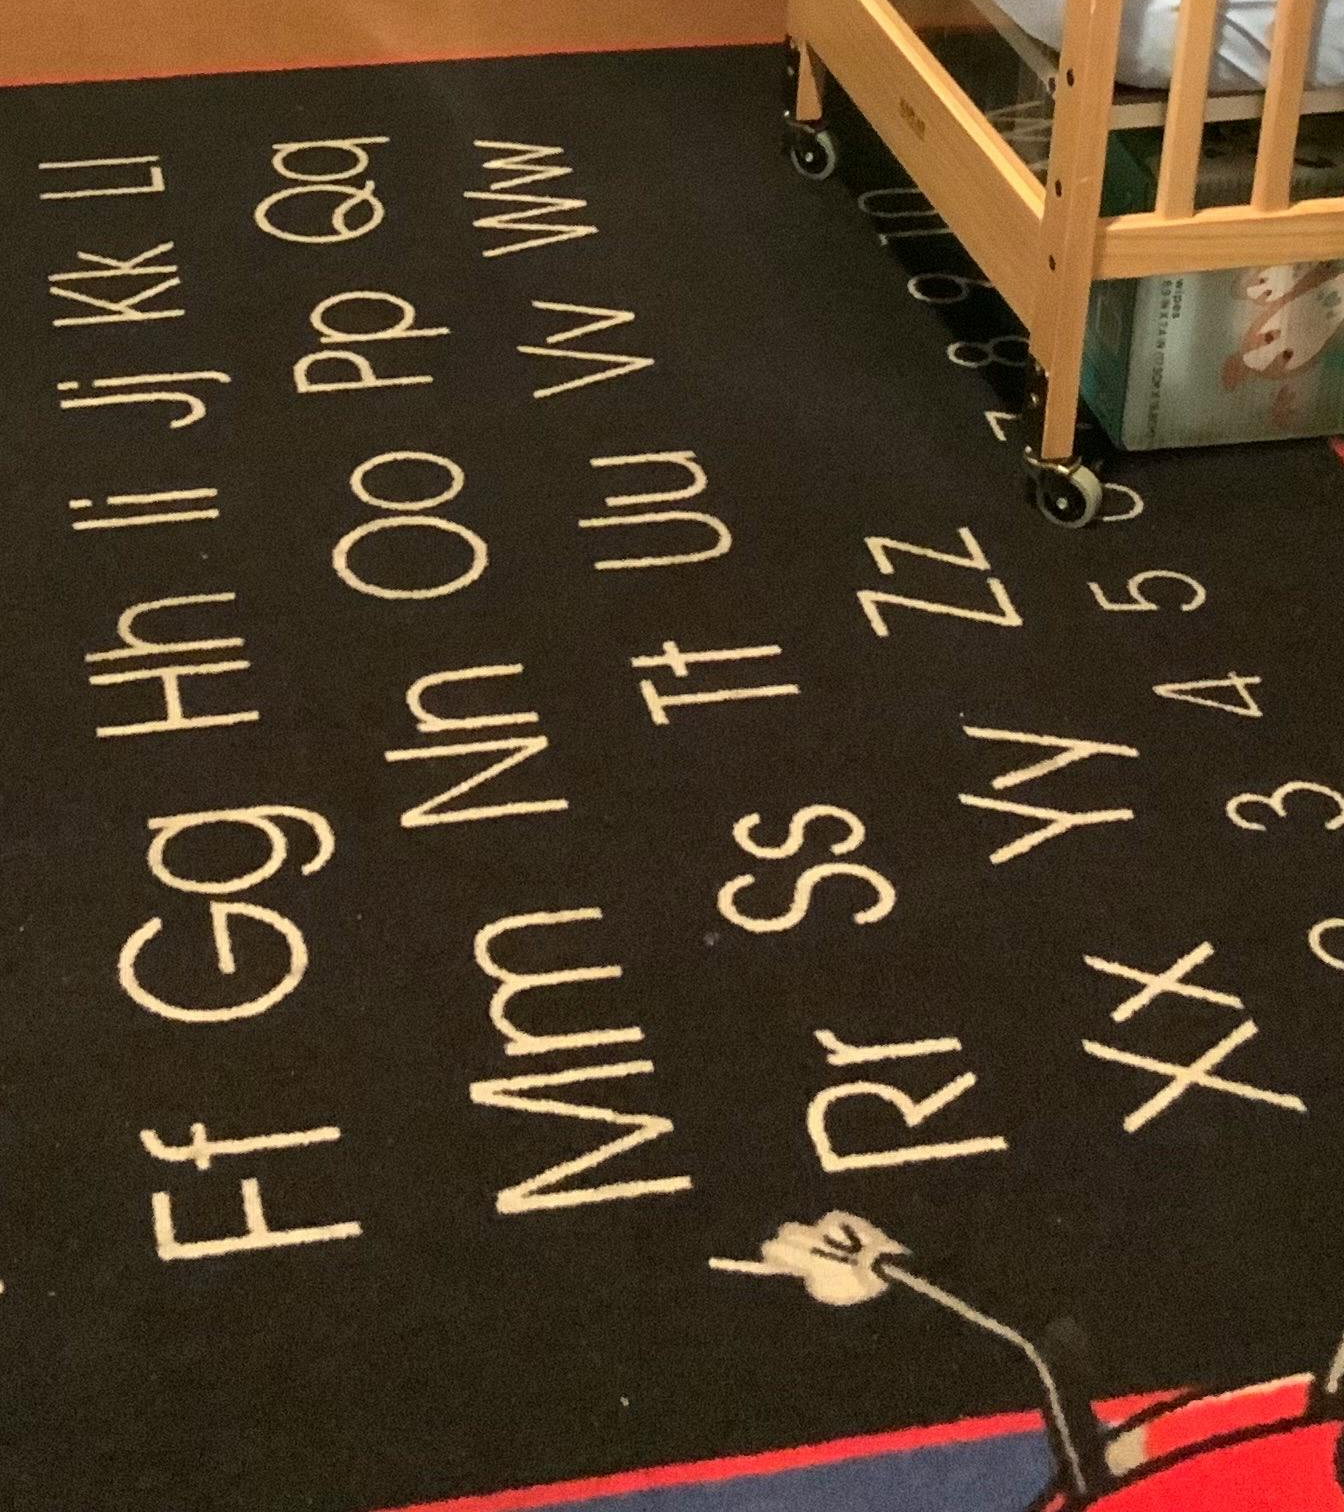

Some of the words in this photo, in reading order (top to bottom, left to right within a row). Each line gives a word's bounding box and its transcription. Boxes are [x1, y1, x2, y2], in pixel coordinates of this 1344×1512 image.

[254, 136, 388, 243] Qq
[464, 140, 597, 257] Ww
[49, 242, 184, 326] Kk
[294, 291, 449, 393] Pp
[1171, 278, 1184, 319] wipes
[57, 371, 230, 428] Jj
[518, 301, 654, 398] Vv
[947, 336, 1031, 368] 8
[332, 451, 488, 599] Oo
[579, 451, 732, 569] Uu
[857, 527, 1022, 637] Zz
[1090, 571, 1206, 611] 5
[86, 593, 259, 737] Hh
[631, 641, 799, 724] Tt
[1154, 673, 1262, 717] 4
[385, 664, 568, 828] Nn
[959, 726, 1138, 864] Yy
[117, 805, 335, 1022] Gg
[718, 804, 896, 933] Ss
[469, 908, 692, 1214] Mm
[1083, 941, 1307, 1133] Xx
[807, 1030, 1008, 1173] Rr
[140, 1123, 362, 1261] Ff
